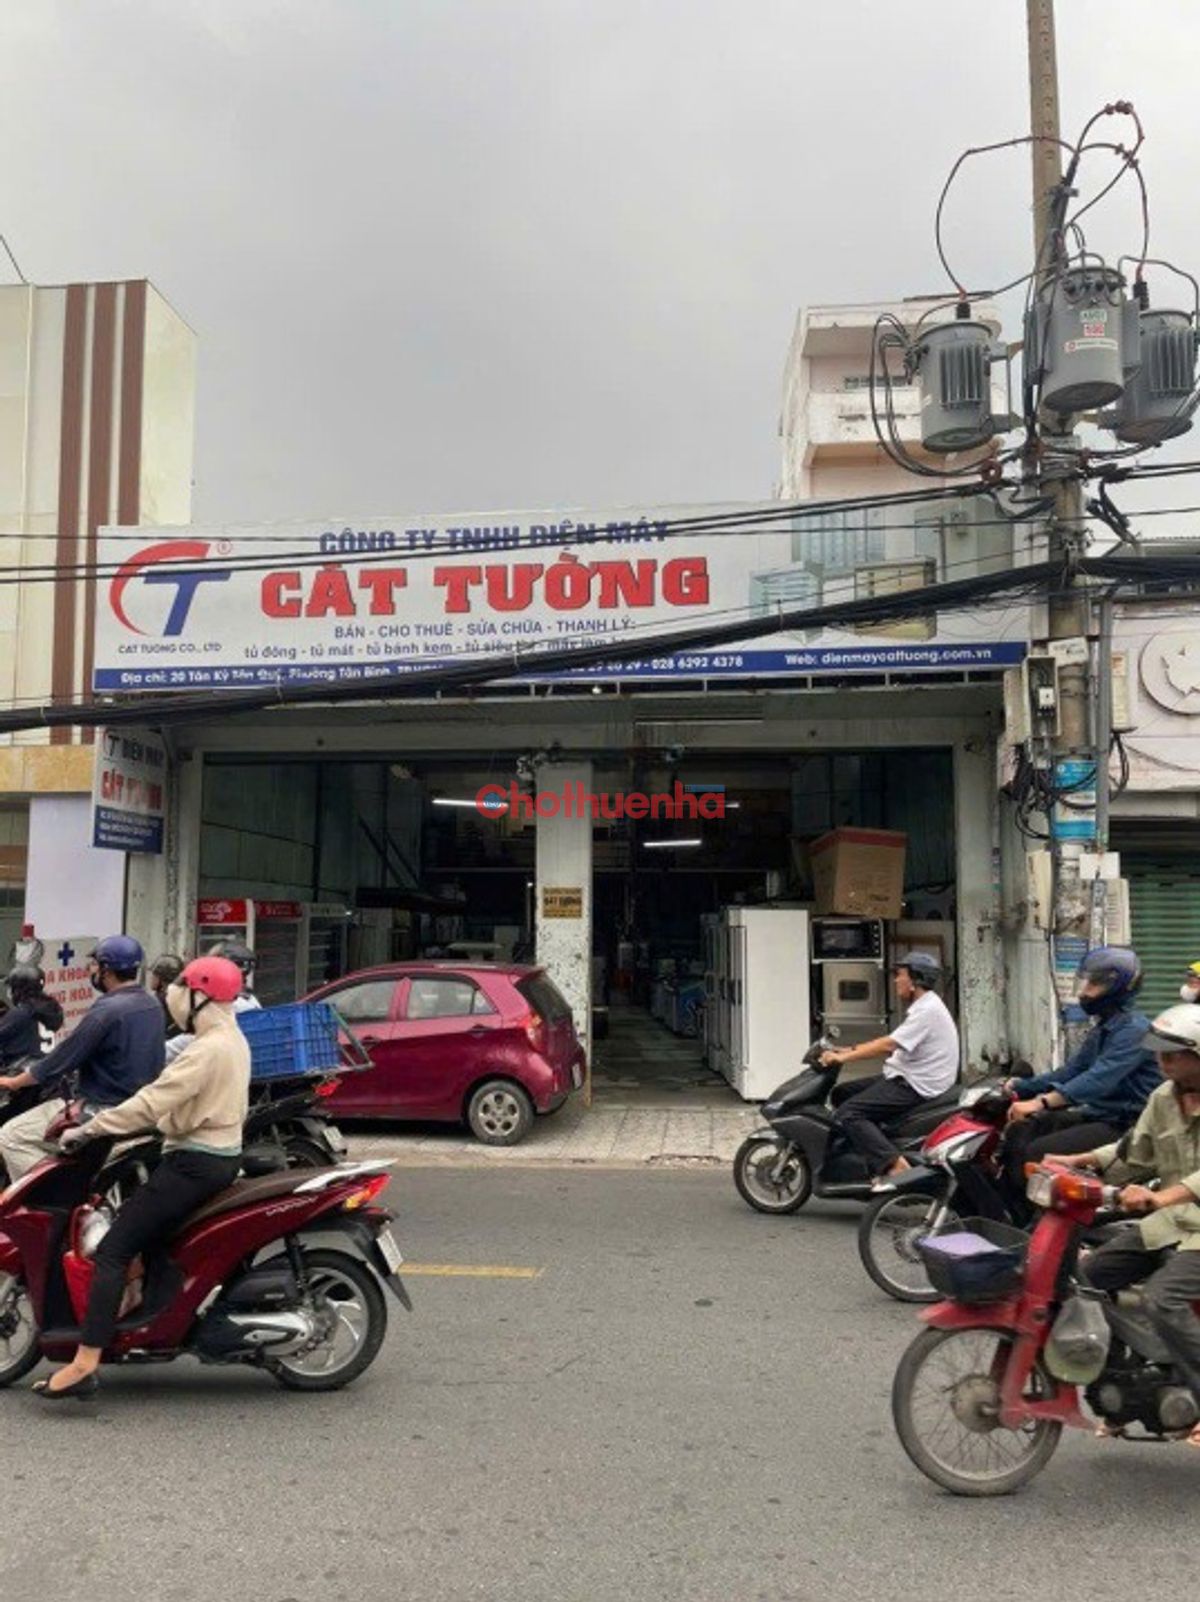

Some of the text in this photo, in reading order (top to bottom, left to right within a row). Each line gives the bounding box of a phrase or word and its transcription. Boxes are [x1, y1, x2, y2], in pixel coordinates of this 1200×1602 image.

[405, 529, 437, 550] TY
[446, 526, 519, 550] TNHH
[434, 553, 709, 613] TƯỜNG
[378, 624, 410, 637] CHO
[557, 620, 607, 632] THANH
